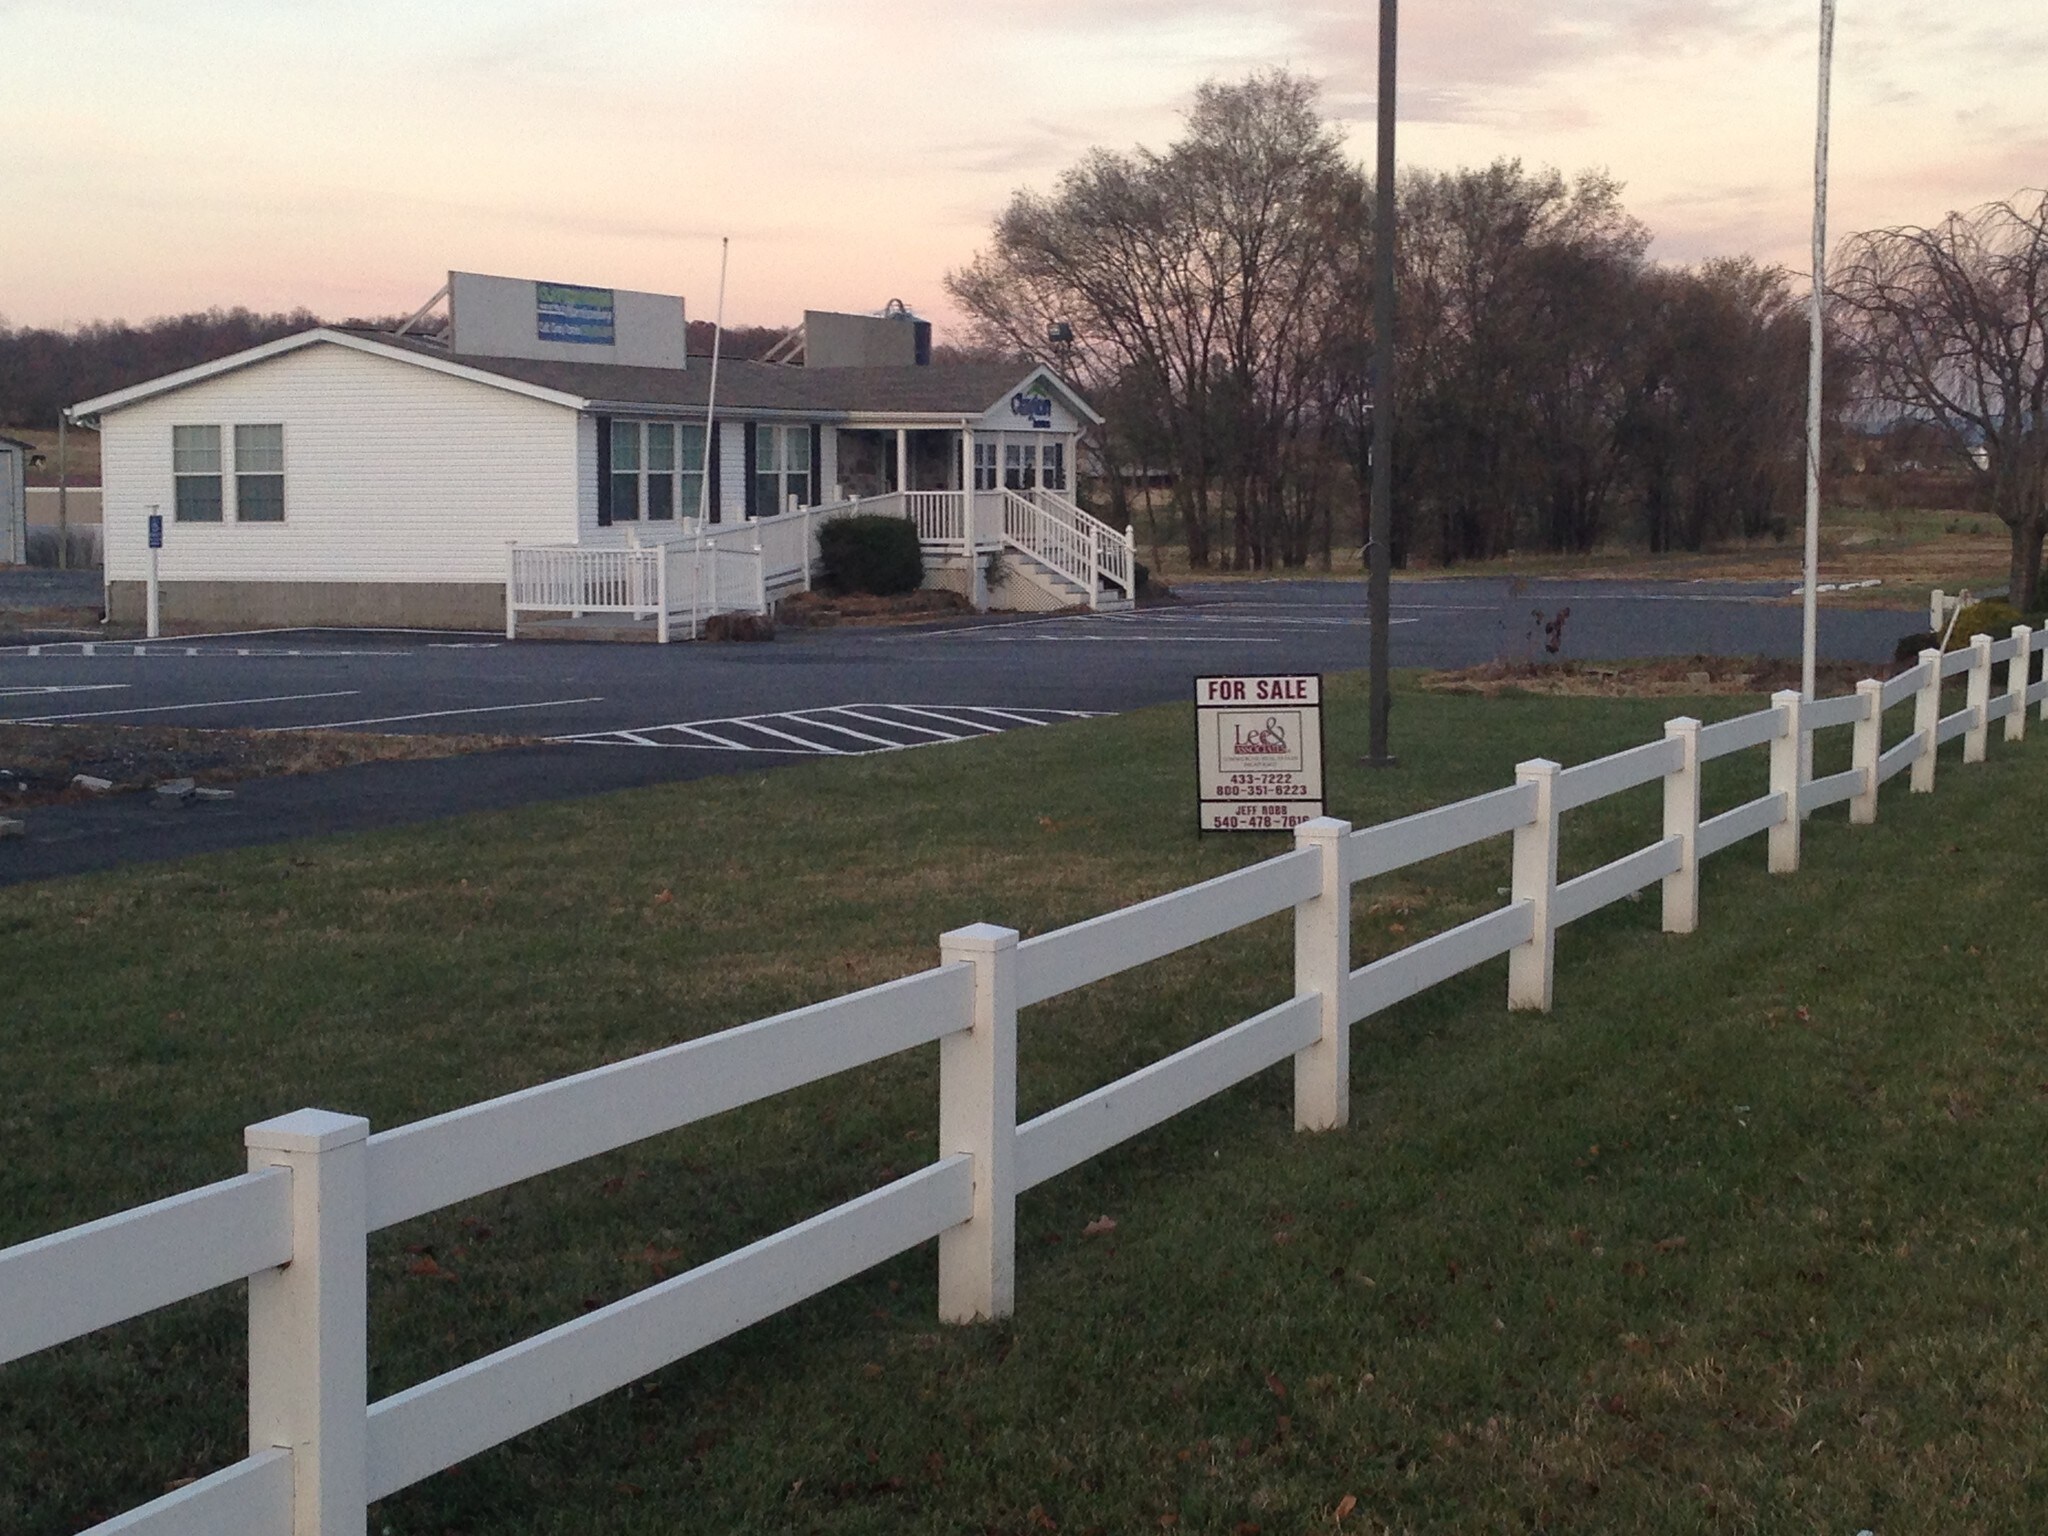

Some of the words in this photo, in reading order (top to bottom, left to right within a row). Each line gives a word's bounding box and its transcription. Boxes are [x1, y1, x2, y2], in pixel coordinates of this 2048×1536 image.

[1208, 680, 1246, 701] FOR
[1256, 679, 1308, 700] SALE
[1230, 774, 1293, 784] 433-7222
[1216, 785, 1308, 796] 800-351-6223
[1235, 805, 1258, 816] JEFF
